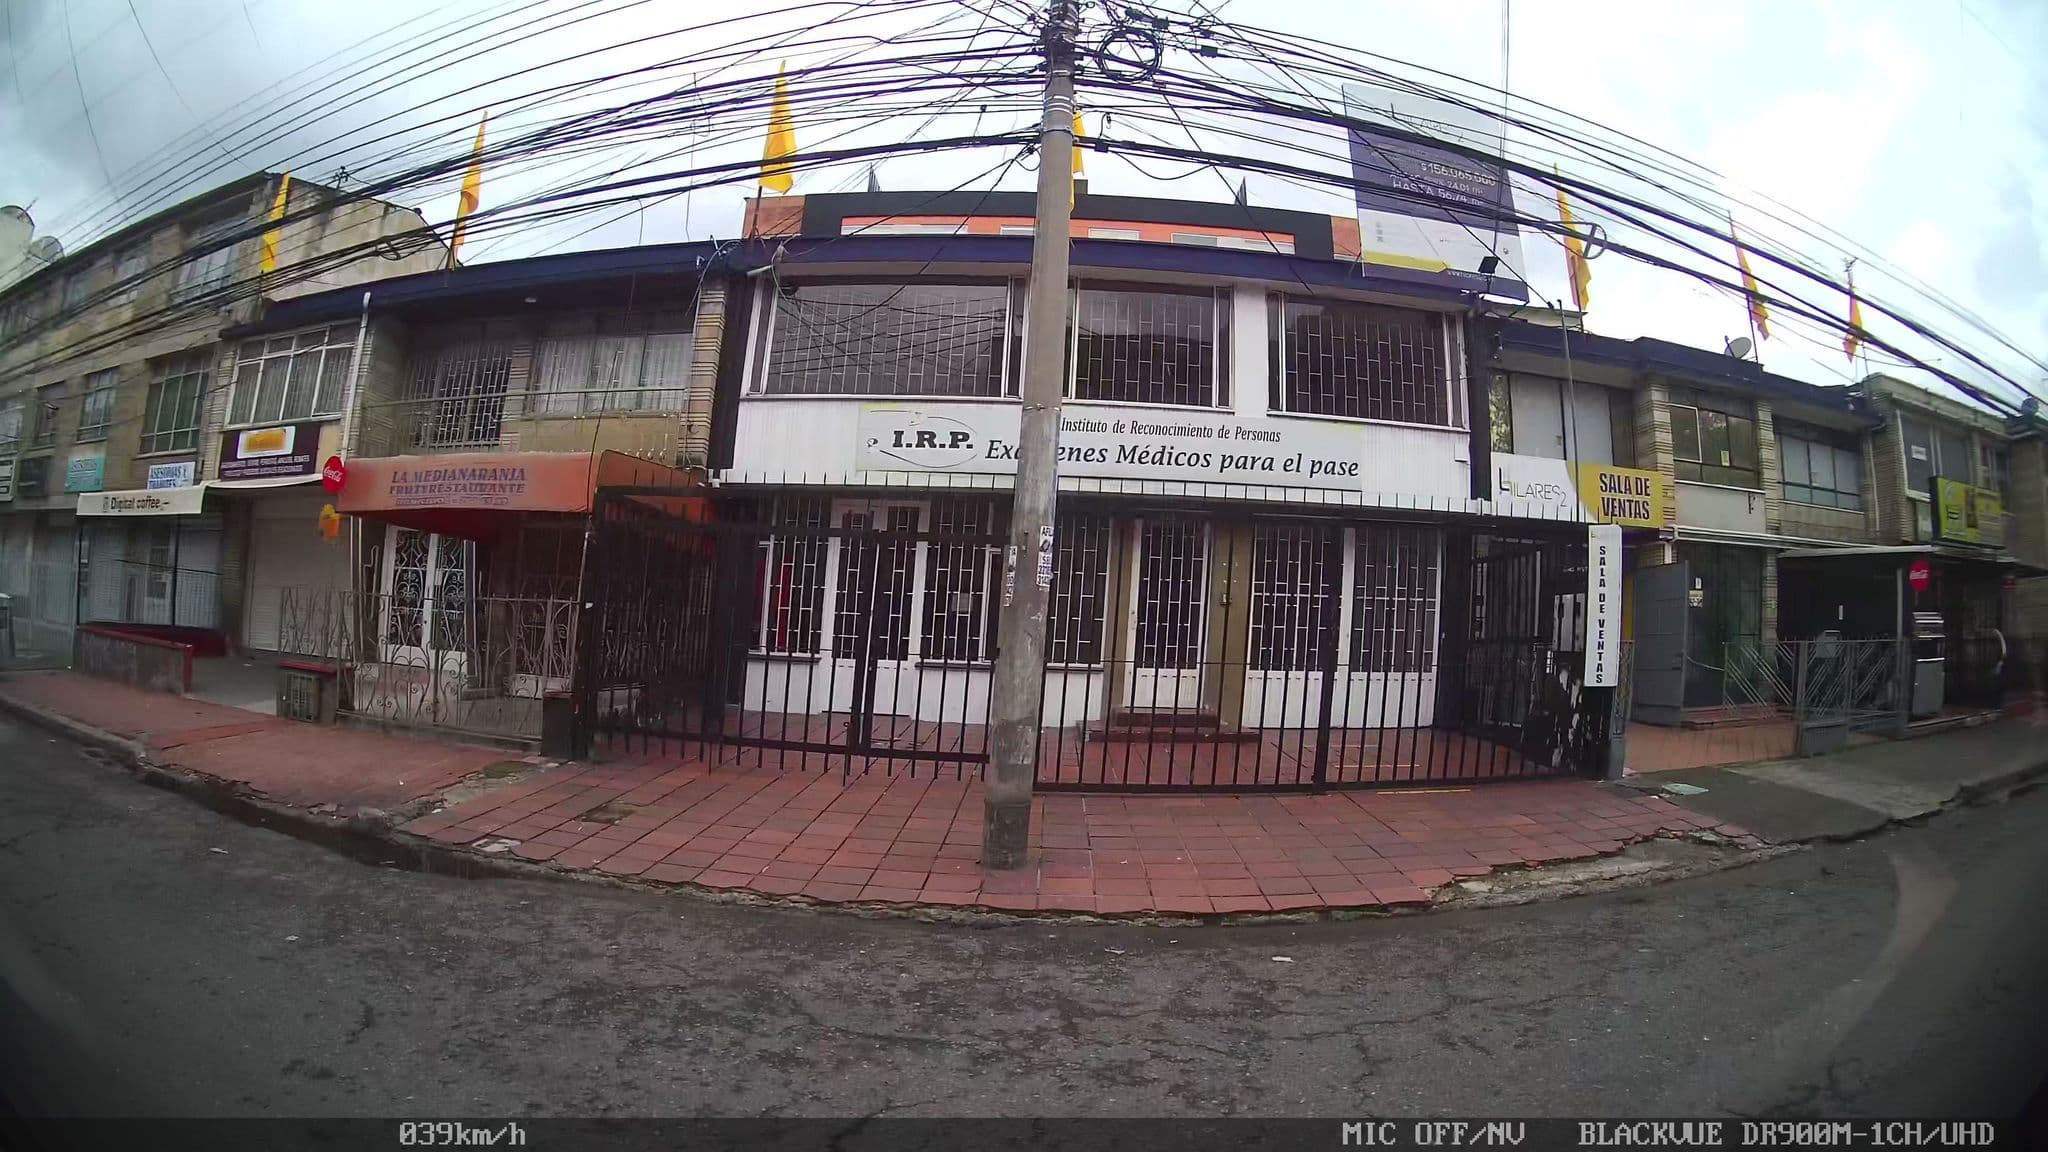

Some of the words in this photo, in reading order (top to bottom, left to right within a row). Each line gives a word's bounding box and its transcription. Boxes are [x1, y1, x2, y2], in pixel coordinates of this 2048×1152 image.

[892, 430, 974, 449] I.R.P.
[1061, 416, 1108, 433] Instituto
[1112, 419, 1126, 434] de
[1130, 420, 1213, 438] Reconocimiento
[1217, 424, 1230, 439] de
[1234, 426, 1281, 443] Personas
[1115, 444, 1212, 469] Médicos
[1219, 453, 1275, 473] para
[1283, 453, 1302, 473] el
[1309, 458, 1360, 479] pase
[392, 471, 408, 483] LA
[1599, 472, 1632, 493] SALA
[1635, 477, 1651, 497] DE
[1601, 498, 1650, 520] VENTAS
[1598, 545, 1606, 588] SALA
[1598, 593, 1606, 614] DE
[1595, 618, 1606, 684] VENTAS
